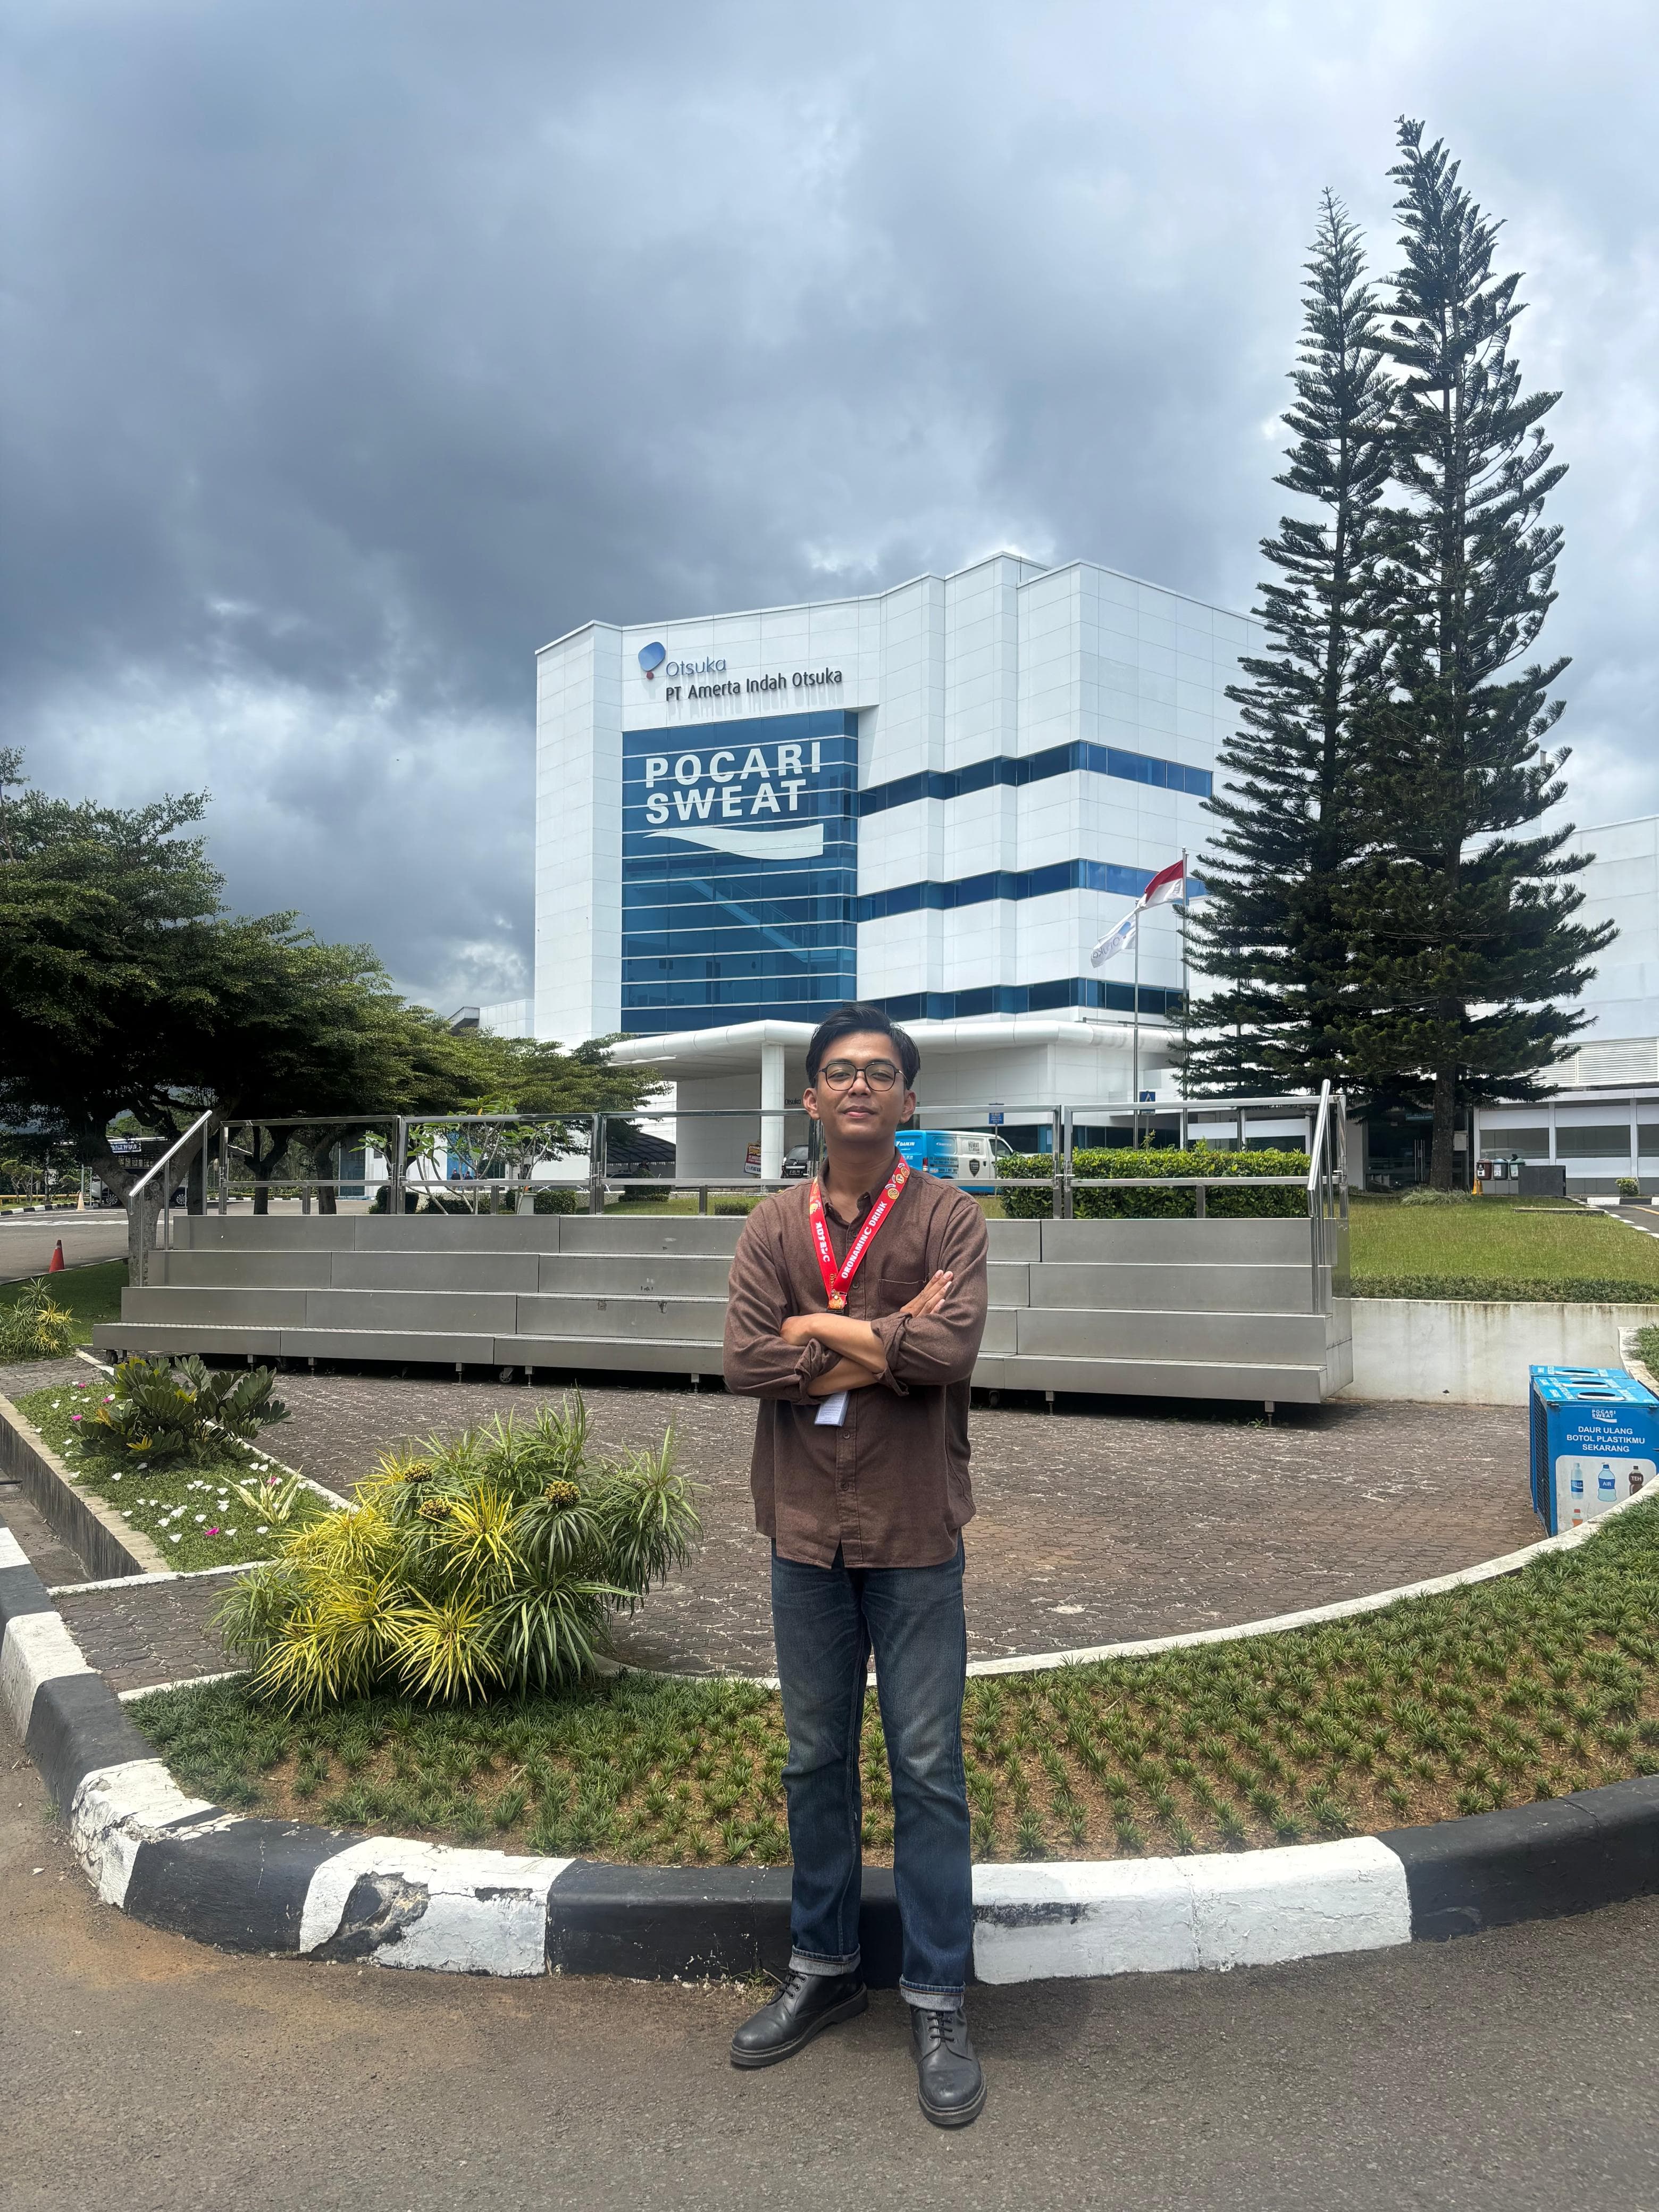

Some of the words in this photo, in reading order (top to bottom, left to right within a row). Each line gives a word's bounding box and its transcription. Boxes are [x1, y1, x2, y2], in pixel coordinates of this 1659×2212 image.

[666, 656, 726, 677] Otsuka
[666, 686, 681, 701] PT
[688, 681, 740, 699] Amerta
[747, 673, 786, 692] Indah
[792, 667, 842, 687] Otsuka
[646, 742, 820, 788] POCARI
[646, 779, 806, 824] SWEAT
[868, 1201, 887, 1227] DRINK
[1582, 1444, 1630, 1452] SEKARANG
[1597, 1436, 1645, 1444] PLASTIKMU
